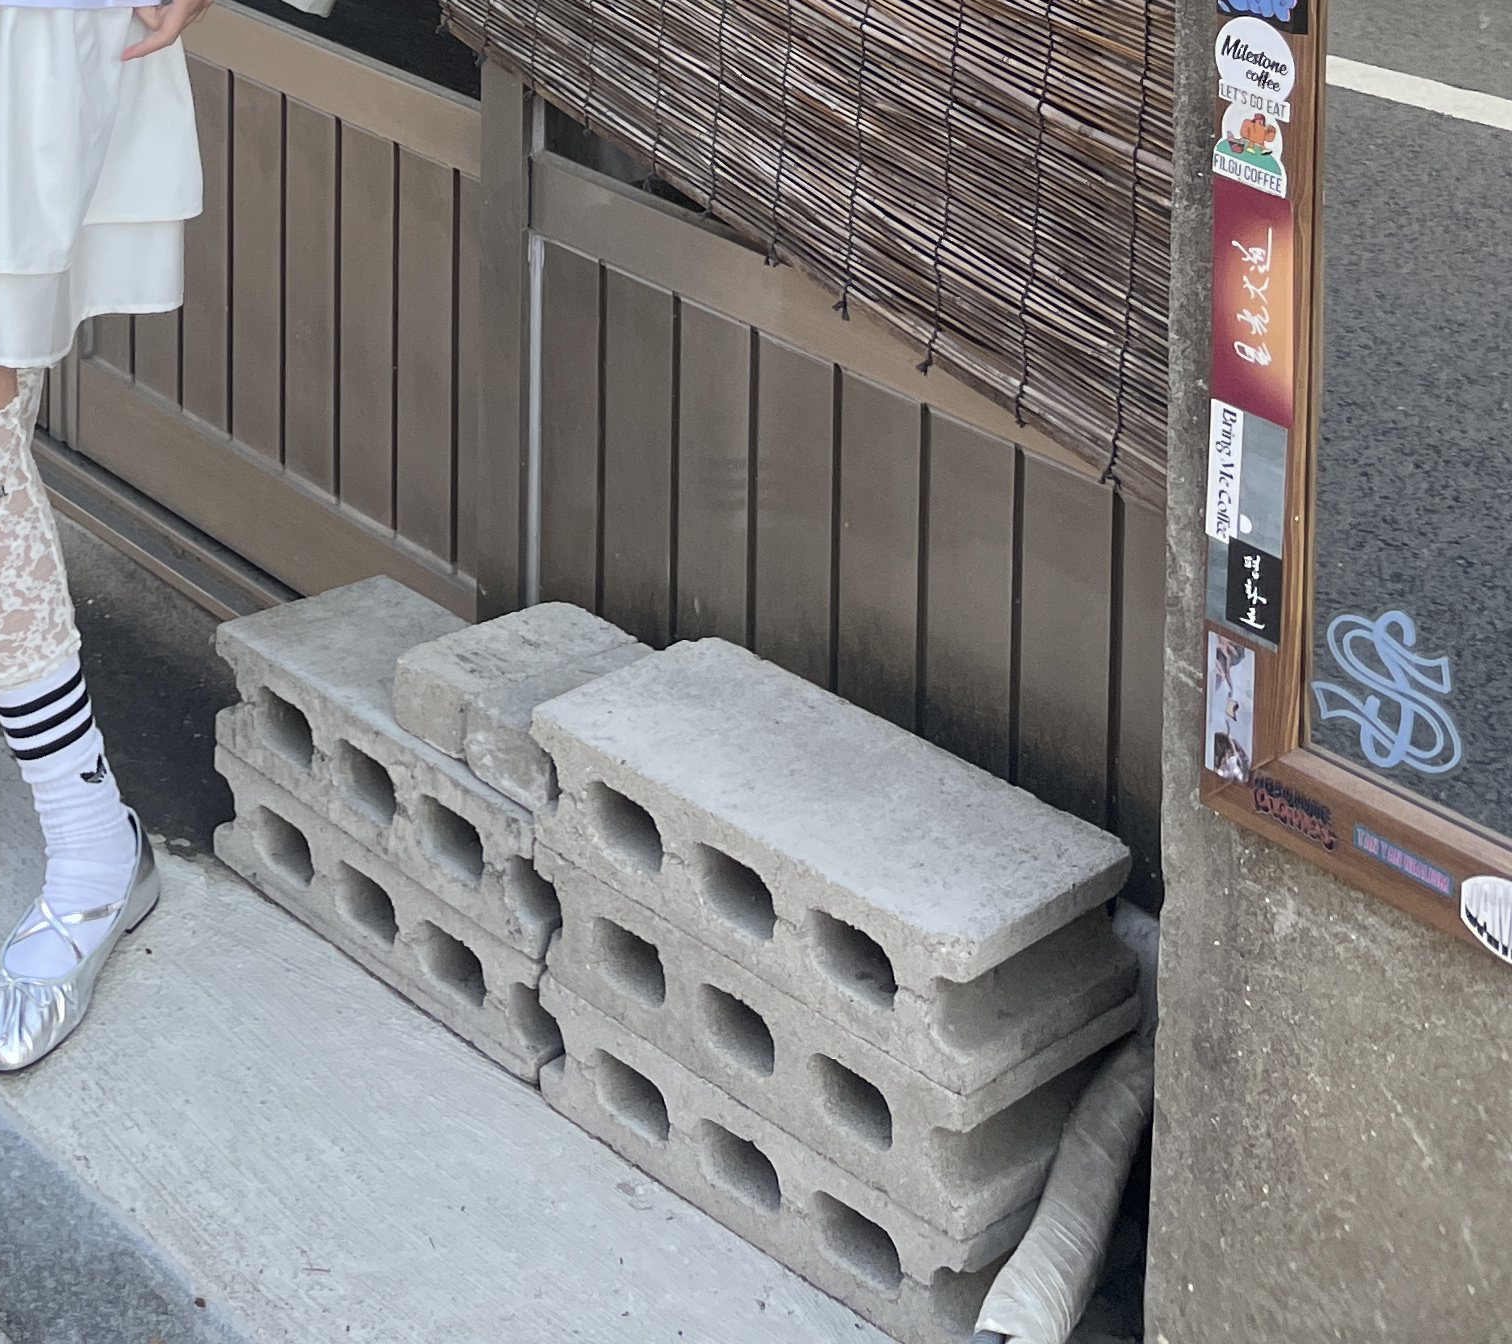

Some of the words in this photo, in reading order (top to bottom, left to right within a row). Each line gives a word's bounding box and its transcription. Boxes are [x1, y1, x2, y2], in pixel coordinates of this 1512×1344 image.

[1220, 34, 1288, 76] Milestone
[1220, 83, 1247, 106] LET'S
[1250, 93, 1263, 111] GO
[1266, 99, 1287, 118] EAT
[1245, 69, 1281, 92] coffee
[1213, 153, 1242, 177] FILGU
[1243, 166, 1283, 193] COFFEE
[1215, 407, 1237, 457] Bring
[1216, 488, 1231, 540] Coffee
